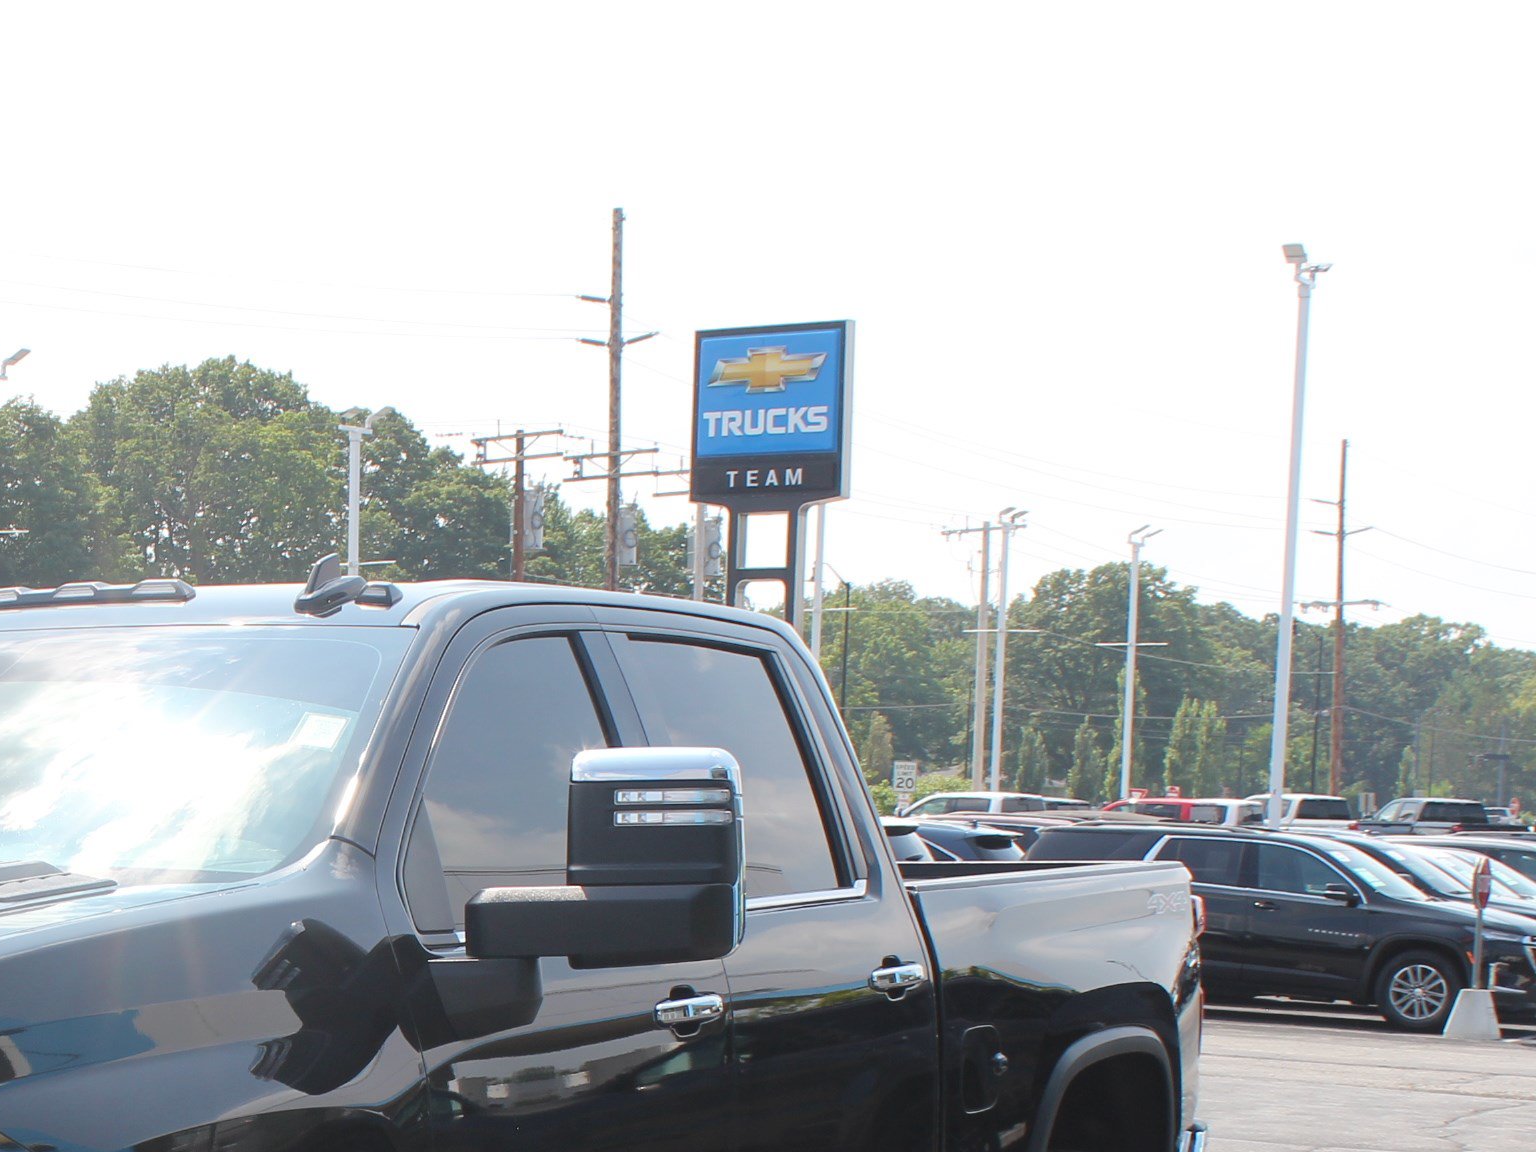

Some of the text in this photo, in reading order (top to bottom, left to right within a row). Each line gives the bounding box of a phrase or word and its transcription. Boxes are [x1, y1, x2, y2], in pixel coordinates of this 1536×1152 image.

[703, 405, 829, 438] TRUCKS
[726, 467, 803, 488] TEAM
[896, 777, 914, 789] 20
